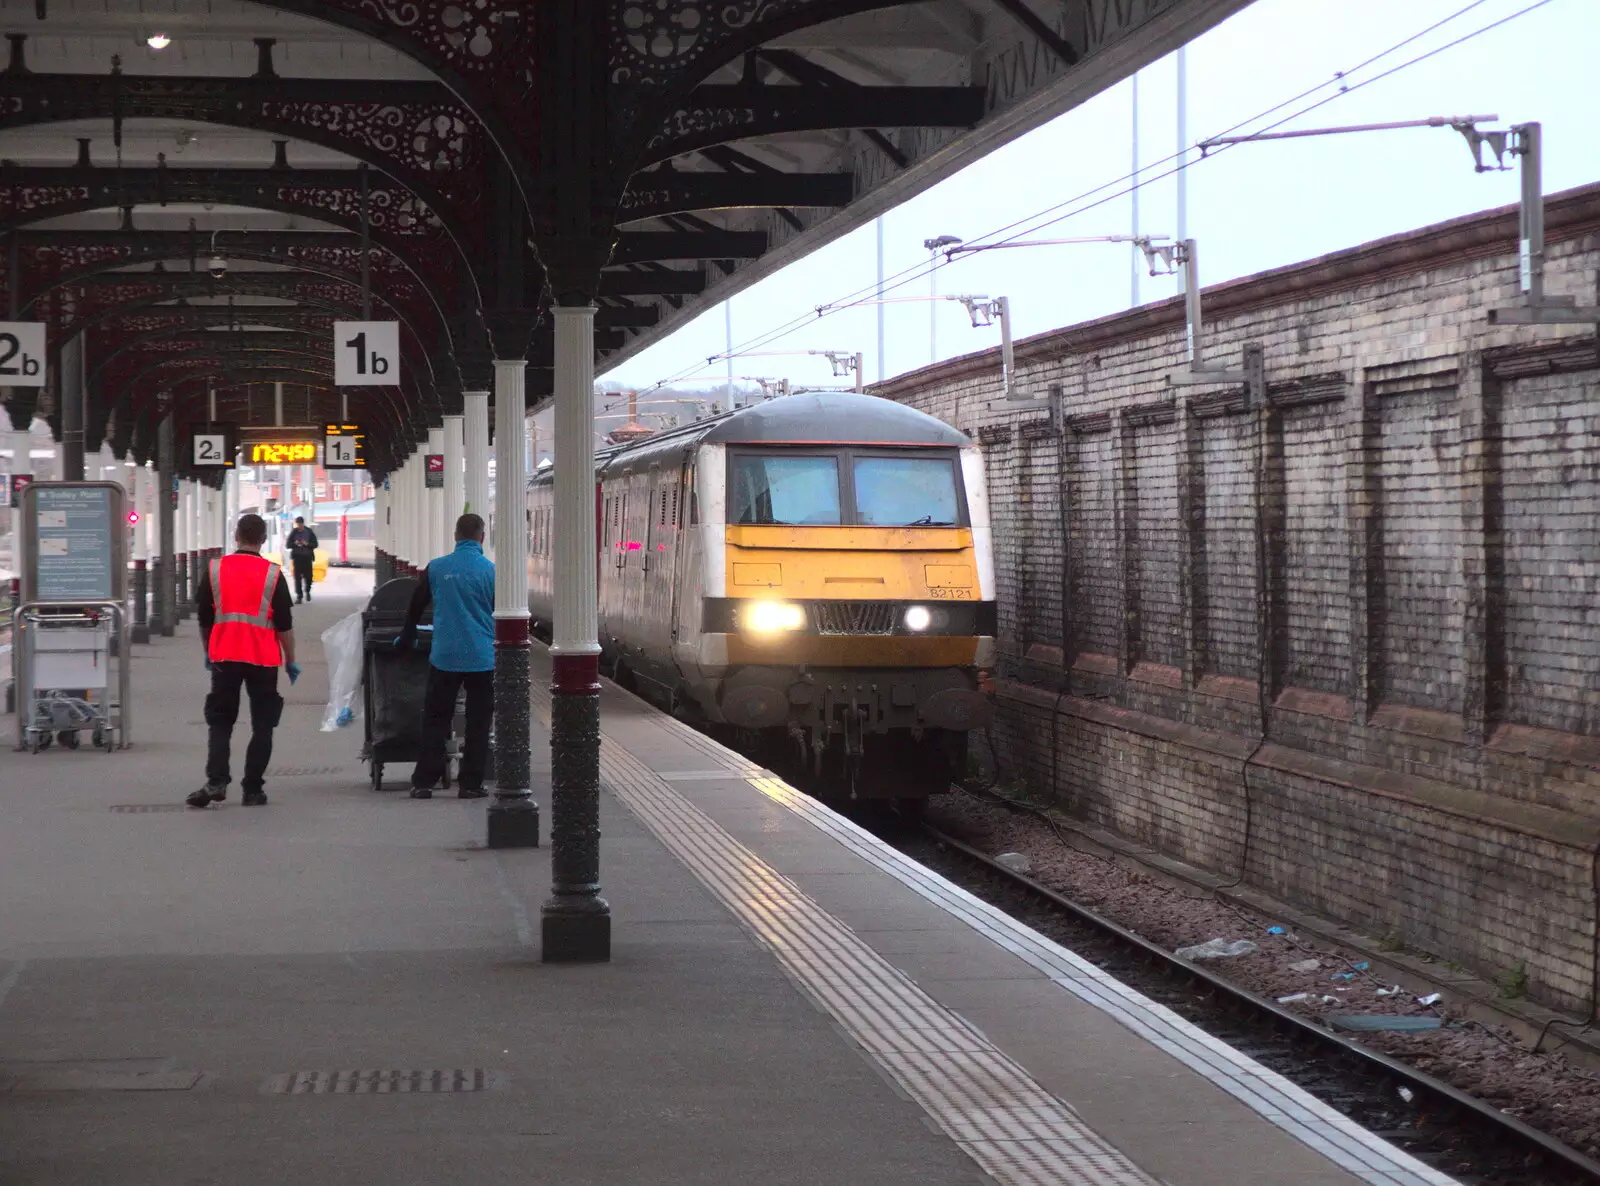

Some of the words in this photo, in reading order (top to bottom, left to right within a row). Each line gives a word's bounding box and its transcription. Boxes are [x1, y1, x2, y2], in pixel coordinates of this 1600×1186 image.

[0, 332, 39, 376] 2b
[346, 332, 388, 375] 1b
[199, 440, 221, 460] 2a
[332, 441, 350, 461] 1a
[930, 588, 972, 599] 82121
